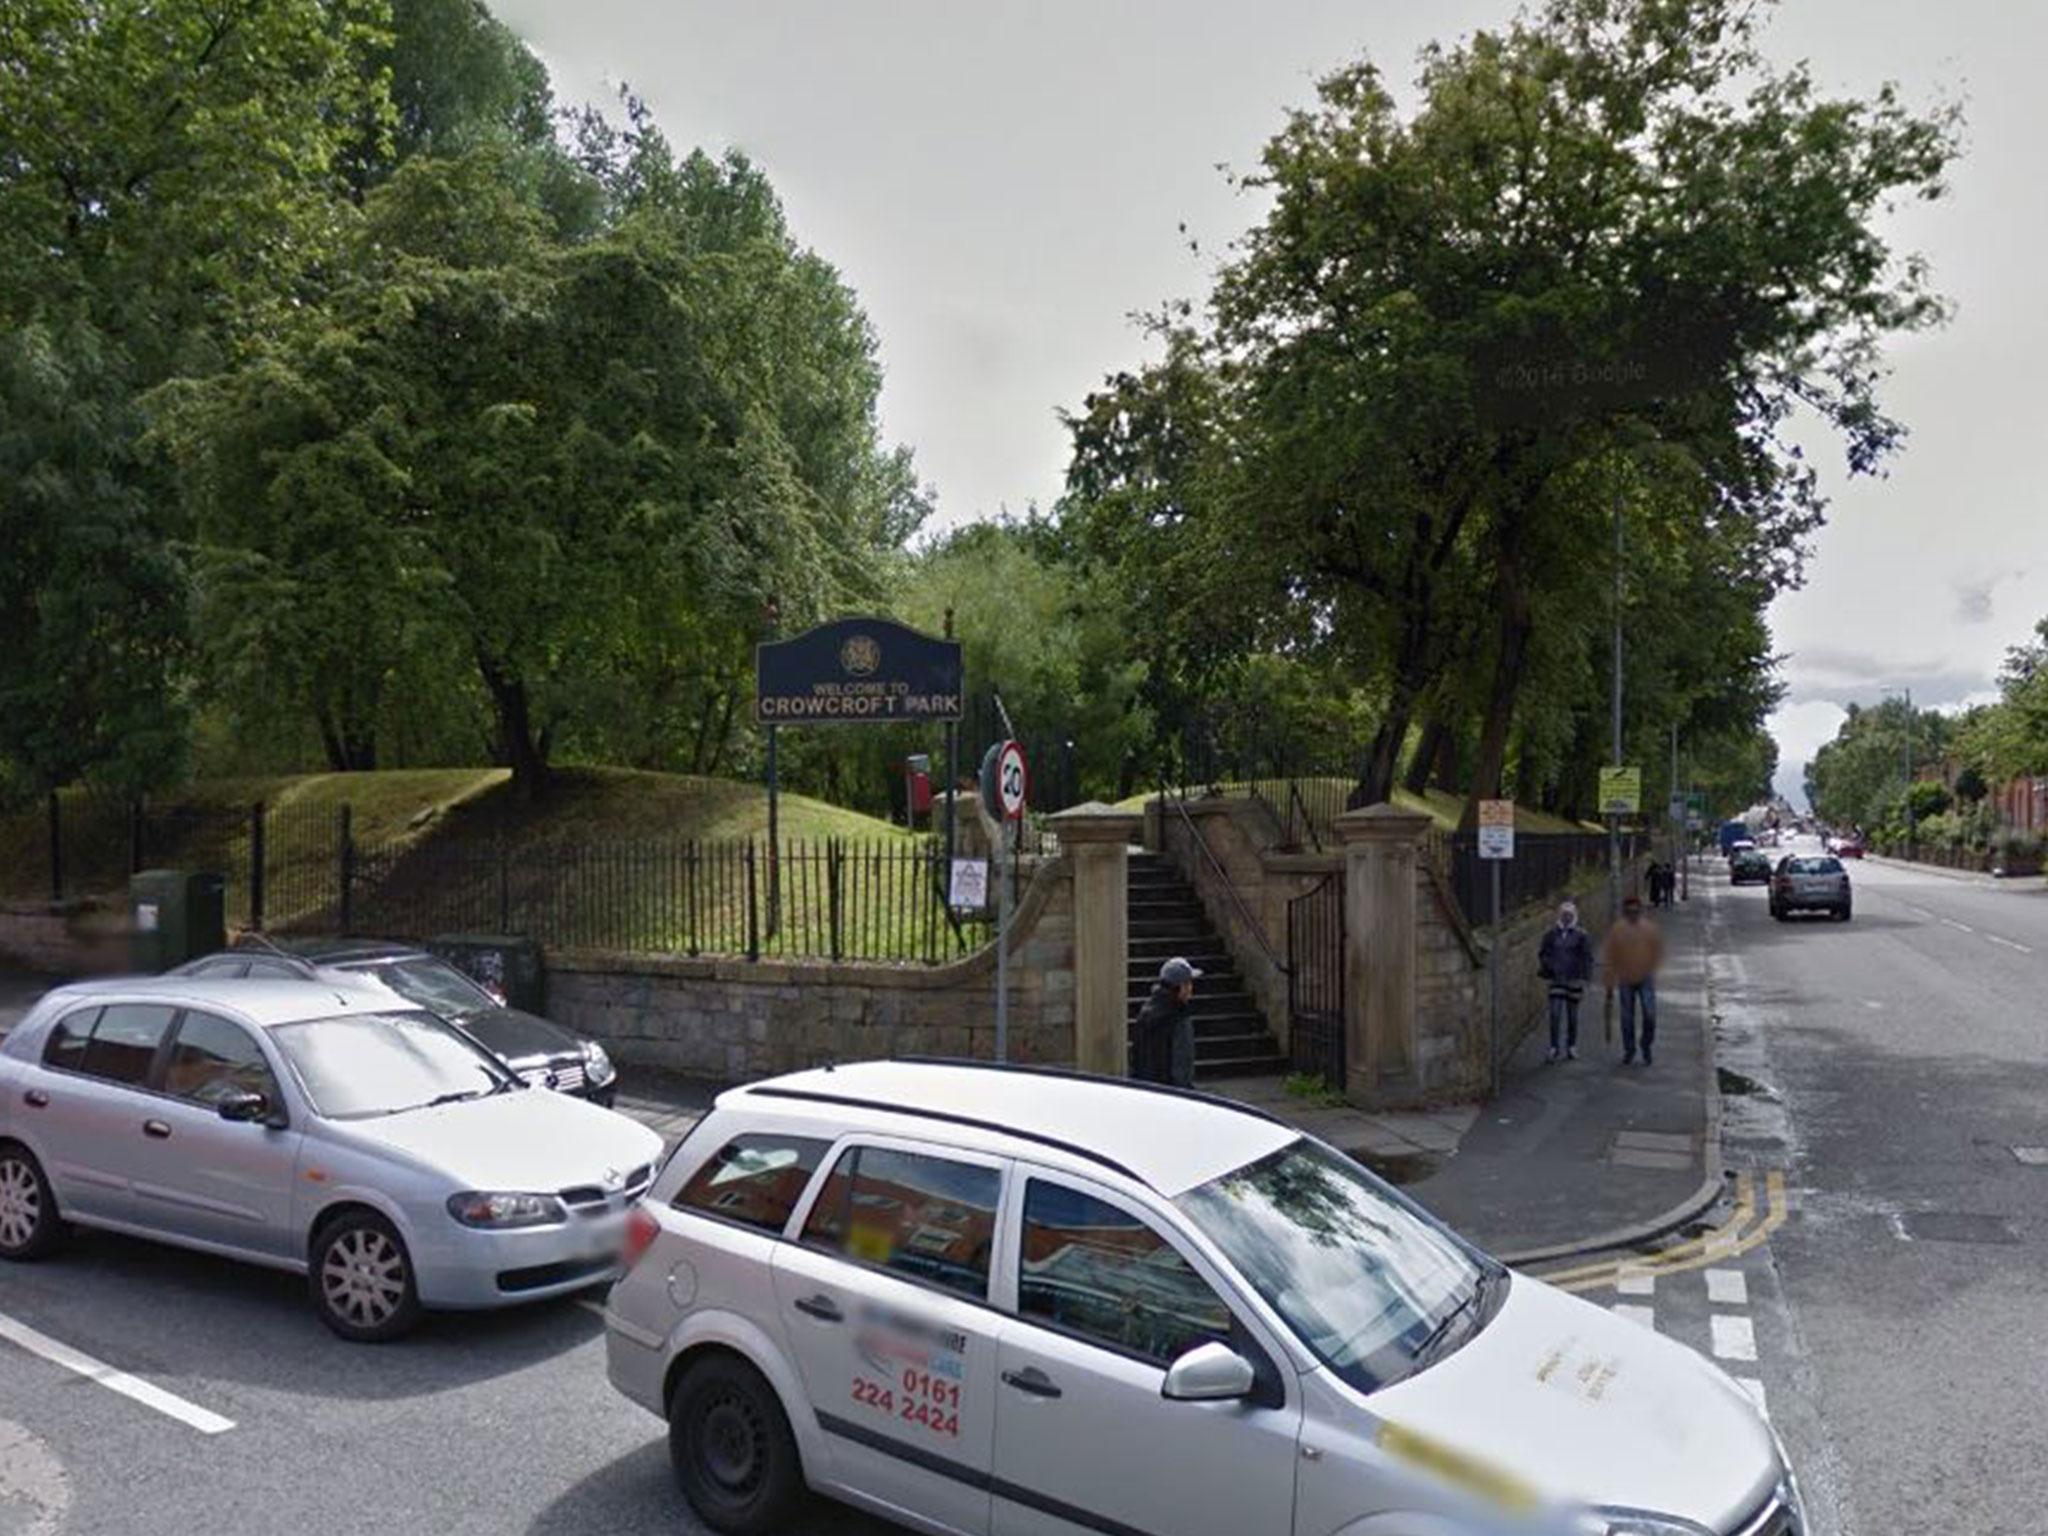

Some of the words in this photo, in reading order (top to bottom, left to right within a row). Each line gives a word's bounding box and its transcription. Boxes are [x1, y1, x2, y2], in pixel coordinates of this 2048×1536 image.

[761, 697, 897, 714] CROWCROFT
[904, 695, 959, 712] PARK
[813, 683, 886, 695] WELCOME
[890, 682, 909, 694] TO
[1003, 764, 1021, 797] 20
[904, 1369, 960, 1409] 0161
[852, 1377, 893, 1411] 224
[901, 1397, 959, 1436] 2424
